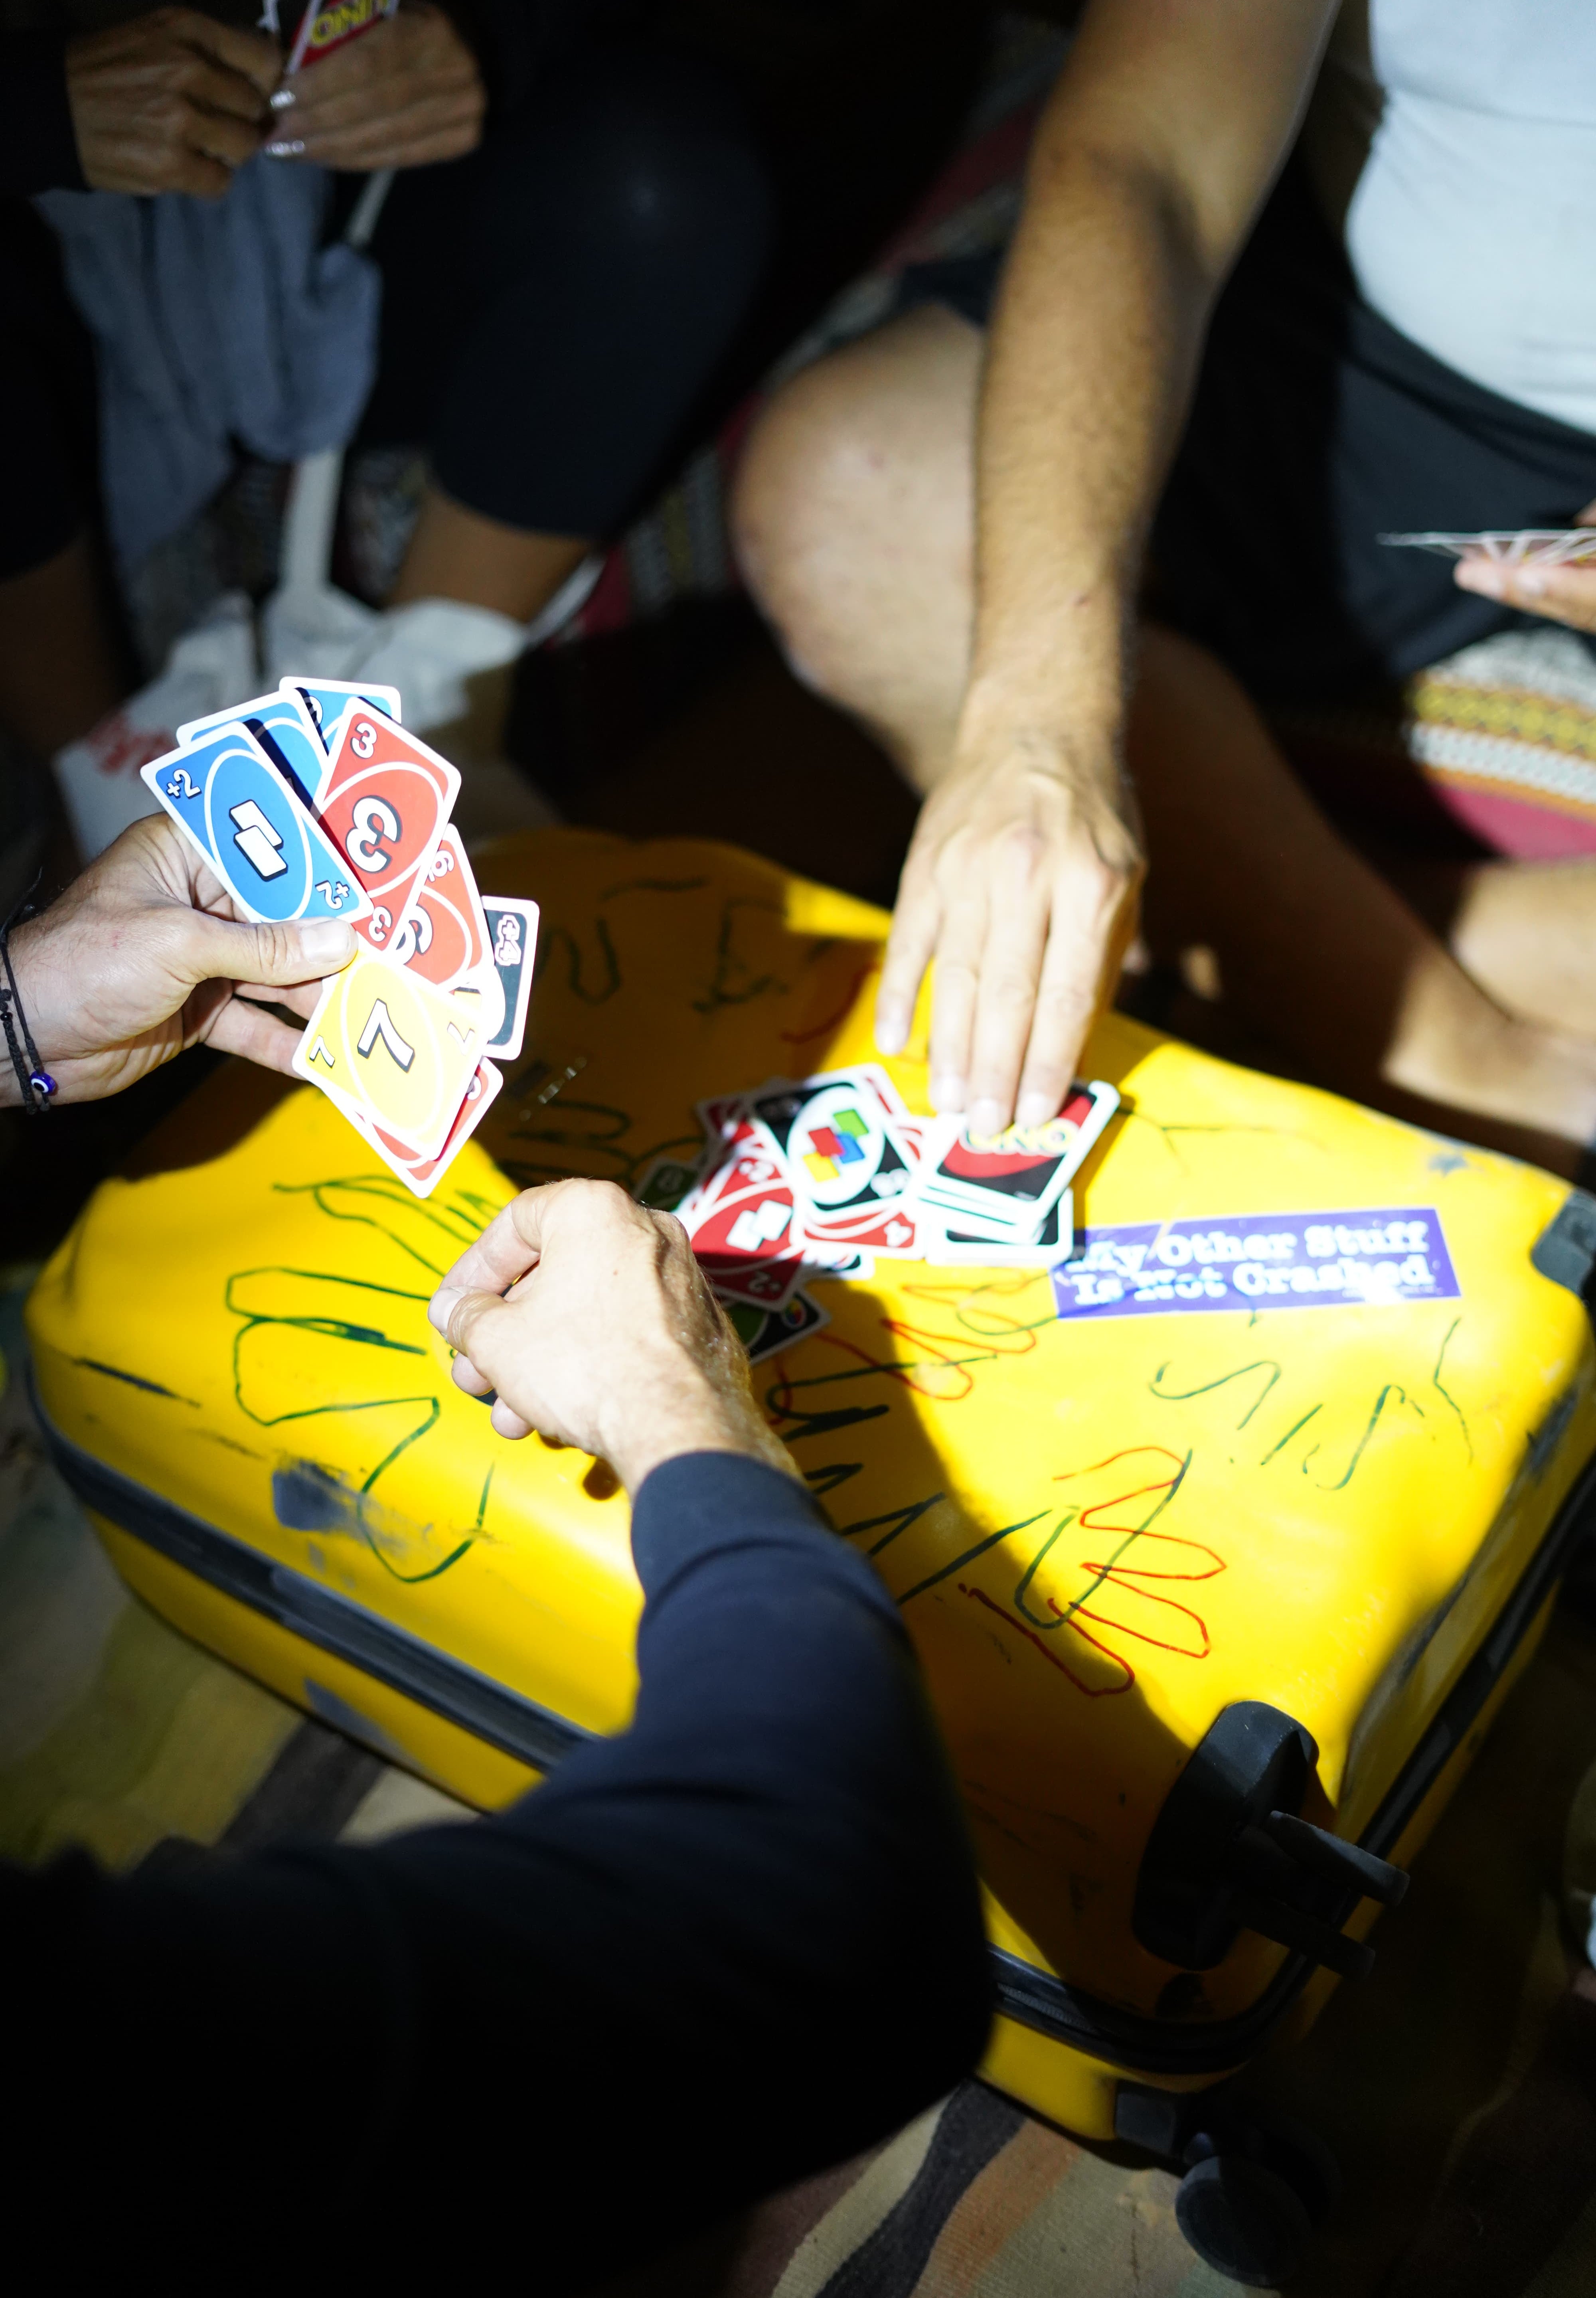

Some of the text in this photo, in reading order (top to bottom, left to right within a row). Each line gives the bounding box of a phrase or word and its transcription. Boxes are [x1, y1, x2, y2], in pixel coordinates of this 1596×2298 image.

[312, 0, 388, 45] NO
[350, 722, 377, 759] 3
[166, 769, 202, 799] +2
[346, 795, 403, 873] 3
[428, 849, 455, 882] 6
[315, 880, 350, 910] +2
[368, 905, 393, 942] 3
[495, 914, 521, 965] +4
[309, 1034, 335, 1068] 7
[357, 997, 415, 1073] 7
[447, 1021, 475, 1056] 7
[1157, 1233, 1297, 1267] Other
[1304, 1222, 1429, 1256] Stuff
[1071, 1273, 1124, 1305] Is
[1131, 1266, 1227, 1301] Not
[1234, 1256, 1435, 1295] Crashed
